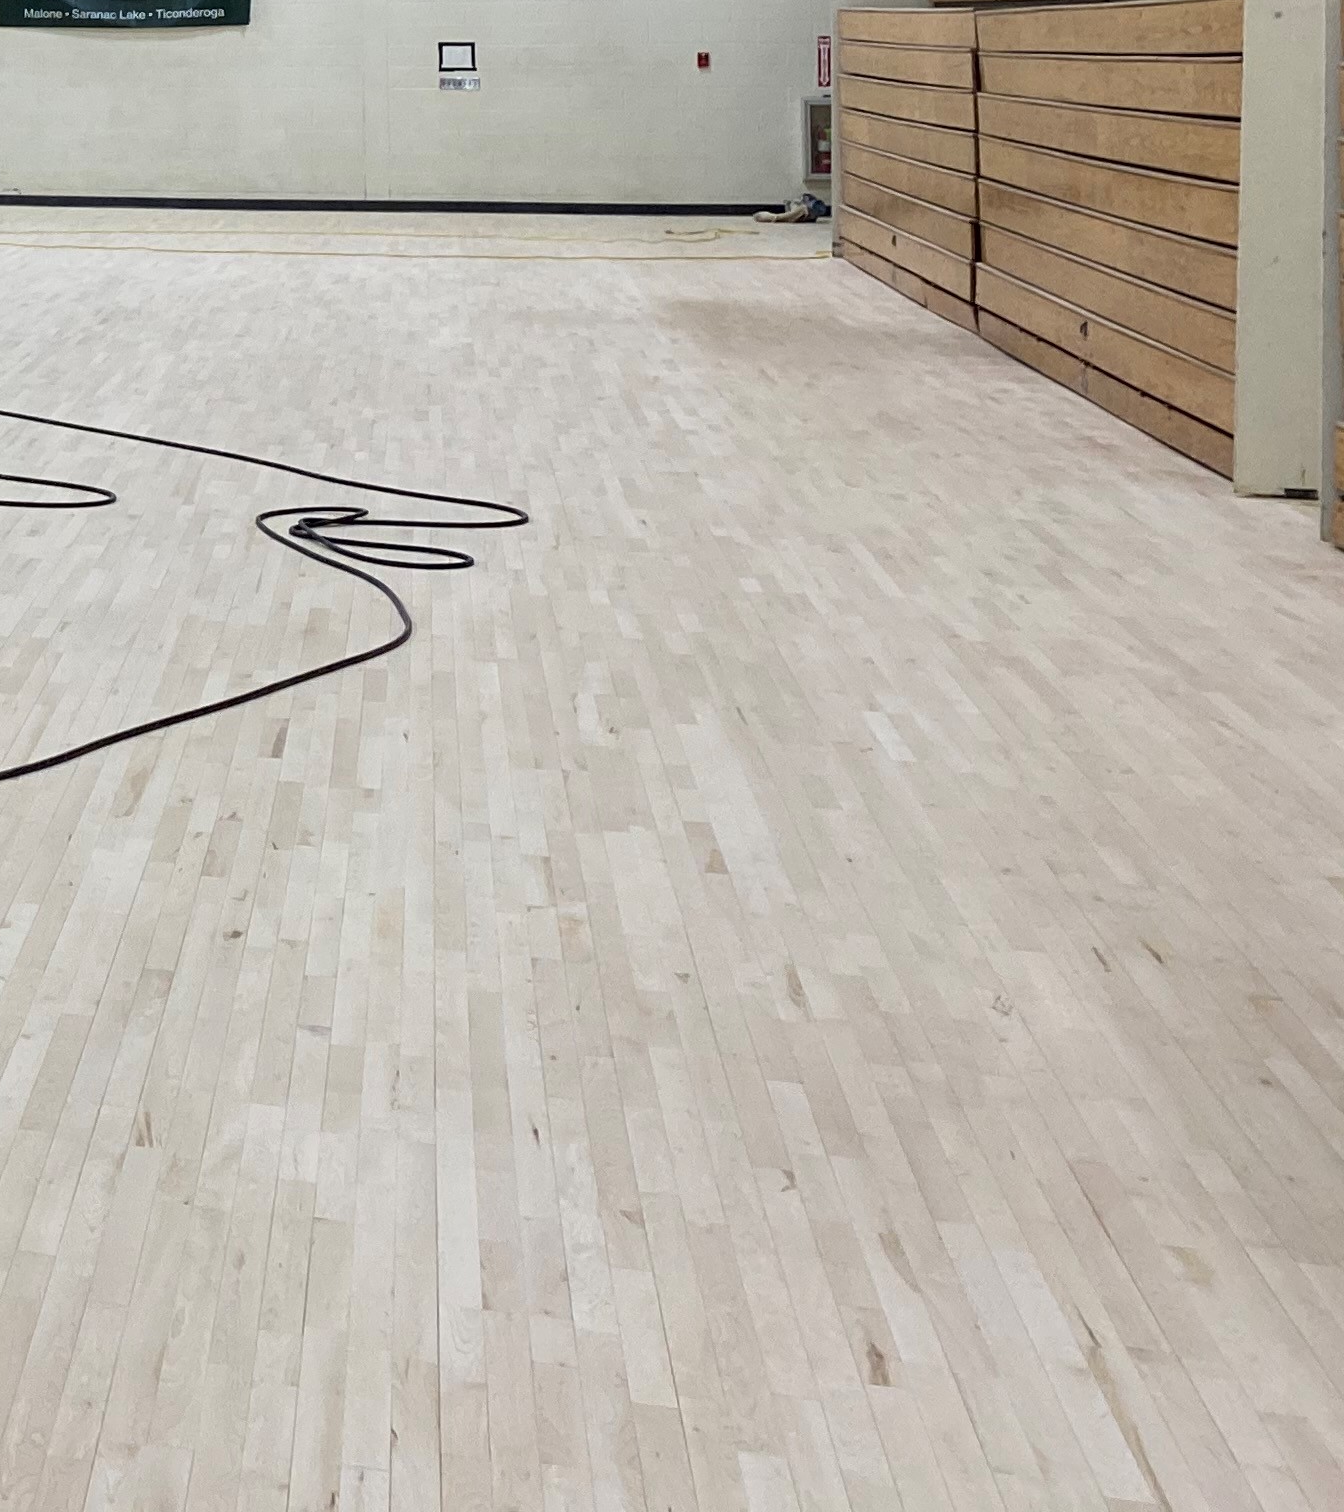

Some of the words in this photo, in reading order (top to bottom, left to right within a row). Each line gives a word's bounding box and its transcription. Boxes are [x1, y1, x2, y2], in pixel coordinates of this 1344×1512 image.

[24, 8, 62, 19] Malone
[72, 9, 117, 19] Saranac
[120, 9, 145, 20] Lake
[156, 8, 225, 19] Ticonderoga
